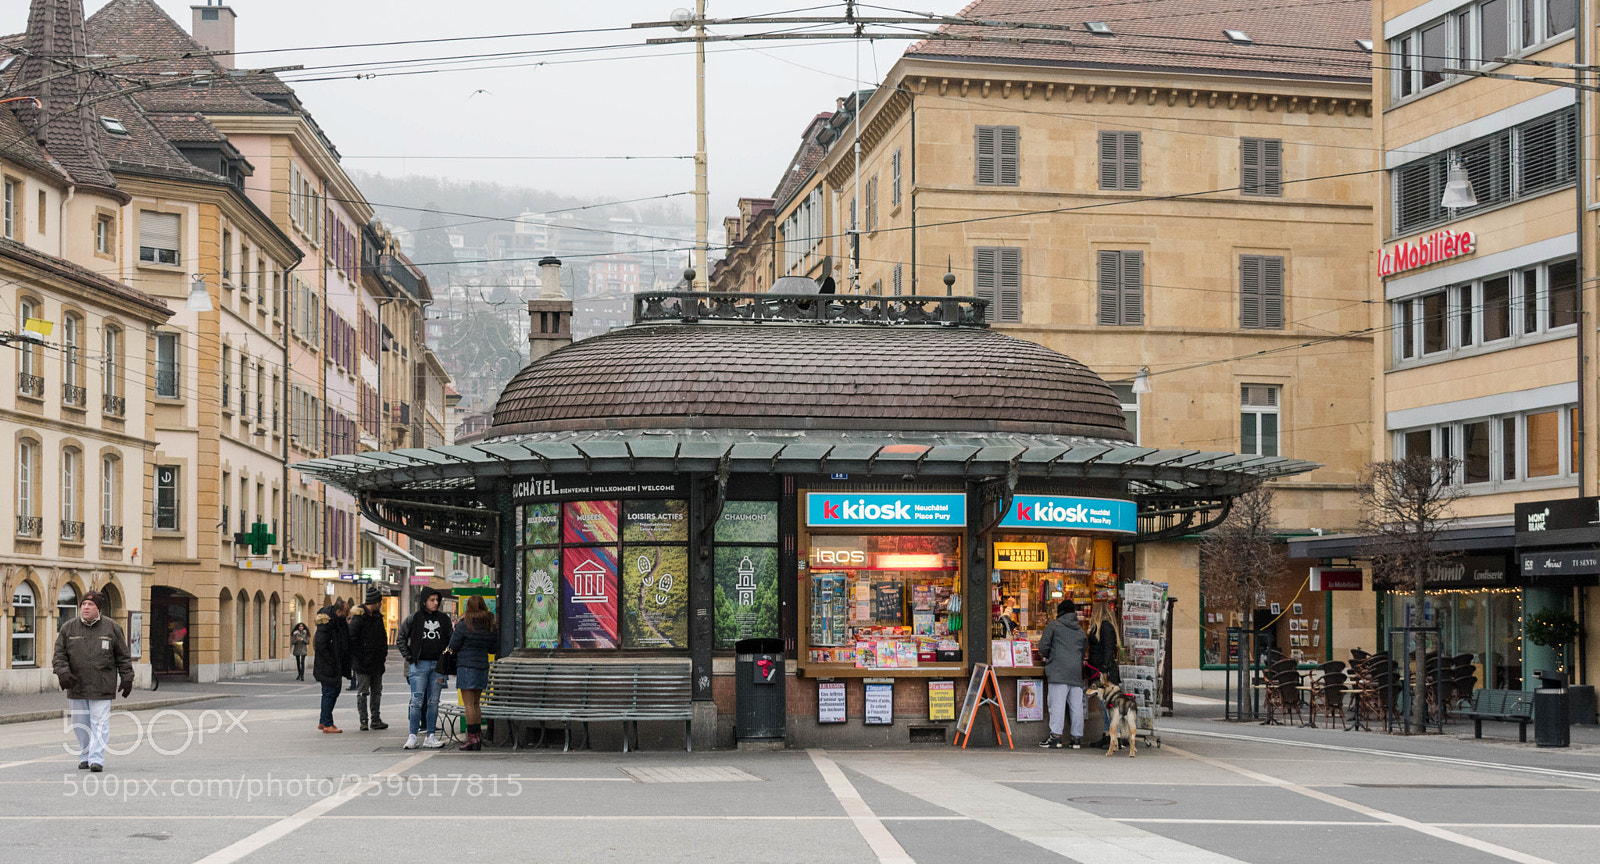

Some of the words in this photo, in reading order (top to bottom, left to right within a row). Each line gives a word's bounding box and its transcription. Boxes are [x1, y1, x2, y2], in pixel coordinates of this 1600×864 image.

[1394, 230, 1472, 273] Mobilière
[560, 486, 589, 494] BIENVENUE
[824, 500, 840, 519] k
[843, 499, 911, 520] kiosk
[1017, 502, 1032, 521] k
[1034, 501, 1089, 523] kiosk
[724, 513, 768, 521] CHAUMONT
[1528, 512, 1546, 522] MONT
[1528, 522, 1546, 531] BLANC
[1473, 569, 1504, 580] Confiserie
